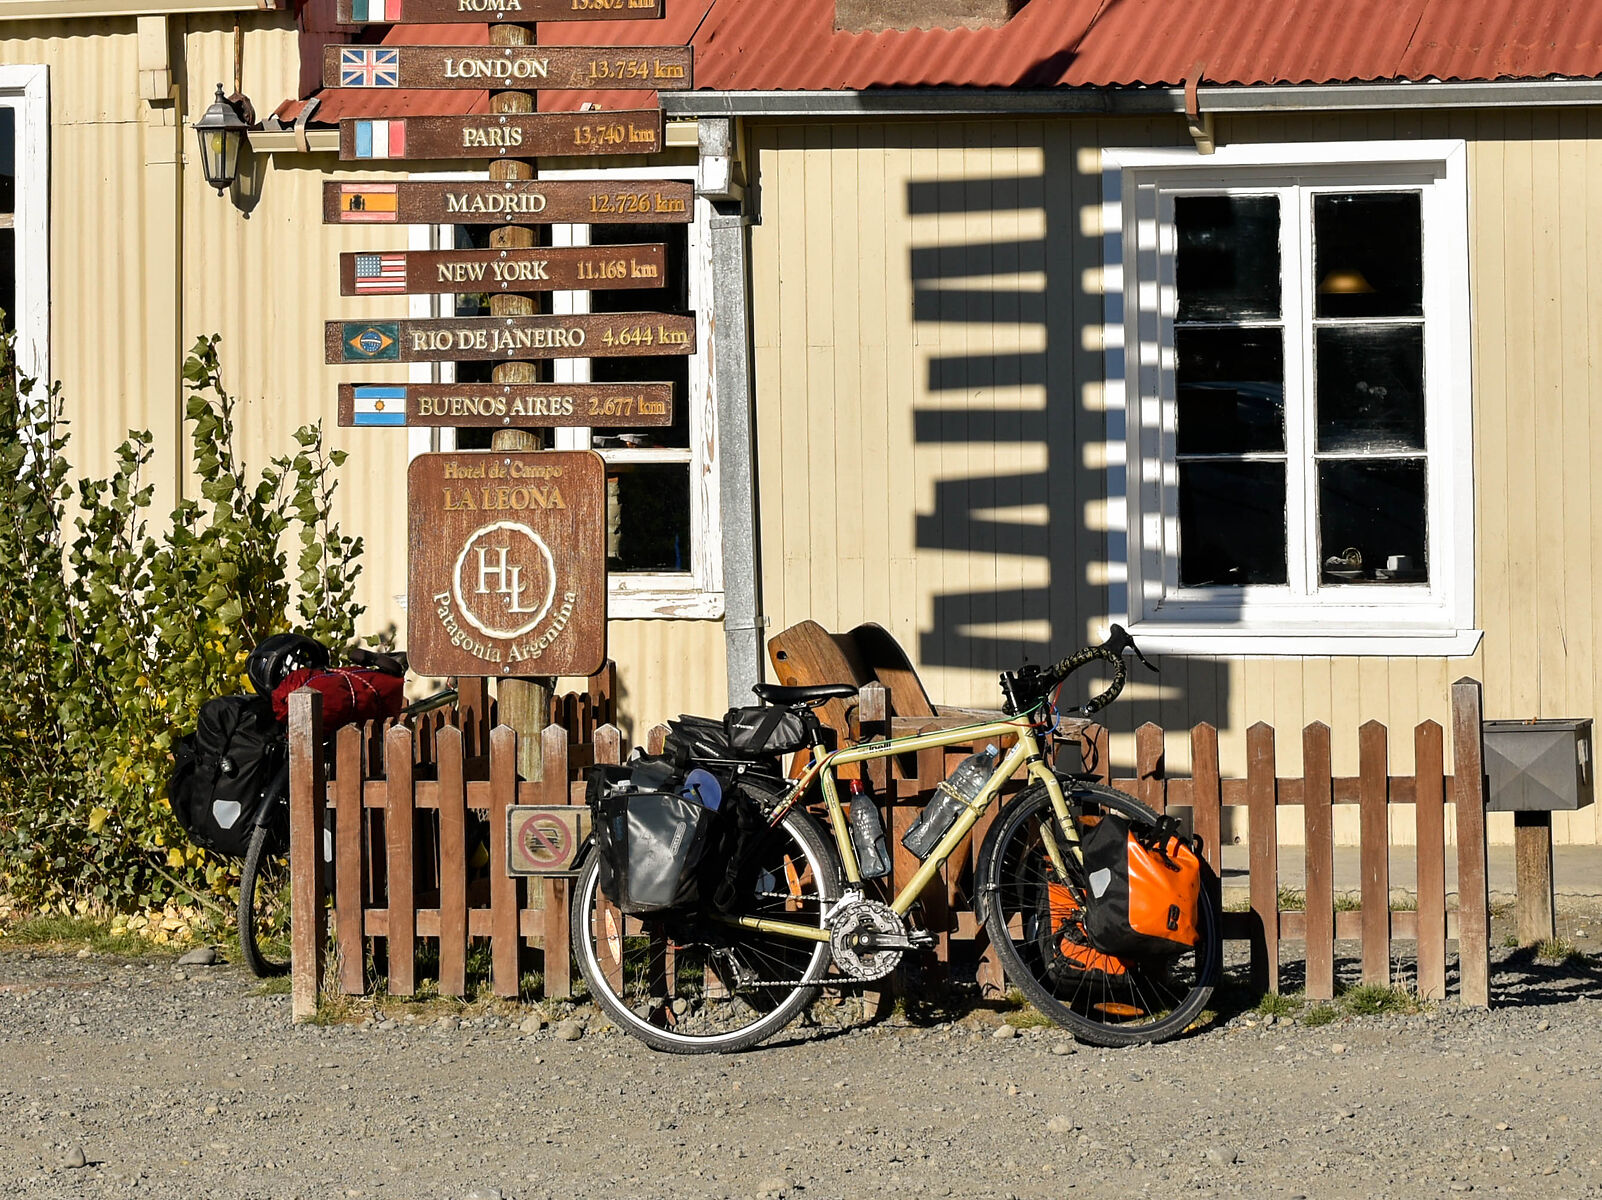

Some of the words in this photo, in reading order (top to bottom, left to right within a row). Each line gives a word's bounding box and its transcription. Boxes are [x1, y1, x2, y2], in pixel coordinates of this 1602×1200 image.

[444, 58, 548, 78] LONDON
[589, 61, 648, 79] 13.754
[654, 62, 684, 78] km
[463, 126, 522, 146] PARIS
[574, 126, 624, 144] 13.740
[629, 124, 655, 142] km
[447, 193, 546, 213] MADRID
[589, 194, 649, 212] 12.726
[655, 193, 685, 212] km
[438, 263, 488, 282] NEW
[491, 261, 549, 280] YORK
[577, 260, 626, 278] 11.168
[631, 260, 658, 278] km
[412, 331, 453, 351] RIO
[458, 330, 486, 349] DE
[491, 328, 585, 349] JANEIRO
[601, 328, 653, 346] 4.644
[658, 326, 689, 344] km
[418, 396, 508, 416] BUENOS
[511, 396, 573, 416] AIRES
[588, 398, 632, 415] 2.677
[638, 399, 665, 414] km
[444, 462, 486, 479] Hotel
[489, 462, 506, 479] de
[509, 461, 562, 479] Campo
[443, 488, 476, 510] LA
[482, 487, 566, 510] LEONA
[508, 592, 577, 663] Argentina
